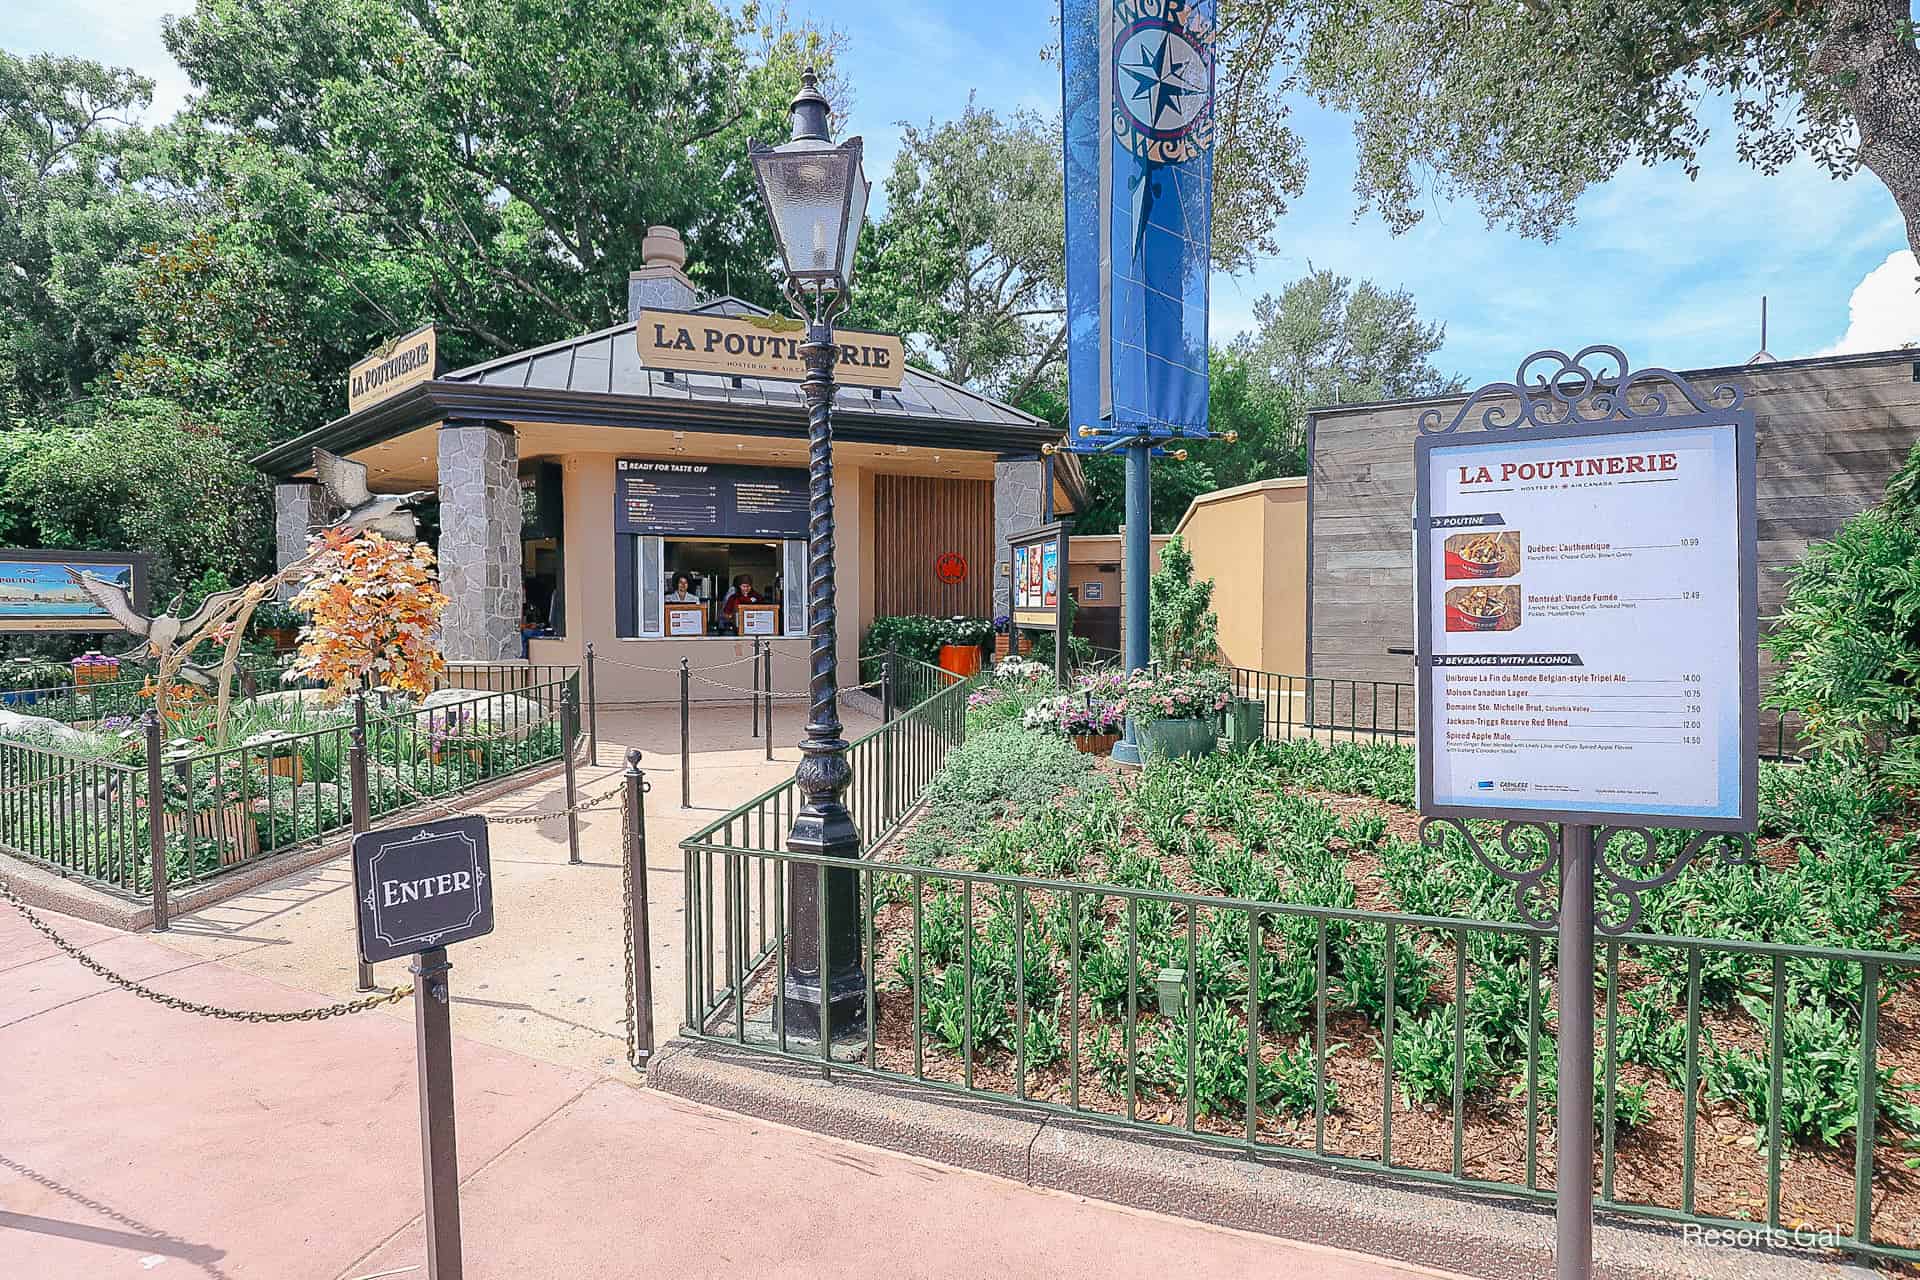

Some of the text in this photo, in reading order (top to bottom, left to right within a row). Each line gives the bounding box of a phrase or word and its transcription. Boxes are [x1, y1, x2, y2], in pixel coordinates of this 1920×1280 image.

[654, 323, 890, 369] LA POUTIRIE
[352, 375, 364, 398] LA
[365, 342, 430, 392] POUTINERIE
[629, 462, 653, 470] READY
[655, 463, 670, 471] FOR
[671, 464, 692, 472] TASTE
[1459, 453, 1678, 485] LA POUTINERIE
[1443, 517, 1485, 526] POUTINE
[1528, 544, 1557, 553] Québec:
[1565, 594, 1591, 602] Viande
[1445, 656, 1573, 665] BEVERAGES WITH ALCOHOL
[1479, 674, 1488, 682] La
[1489, 674, 1500, 682] Fin
[1502, 674, 1511, 682] du
[1513, 674, 1537, 682] Monde
[1538, 674, 1588, 684] Belgian-style
[1591, 674, 1612, 684] Tripel
[1612, 674, 1626, 682] Ale
[1446, 688, 1472, 696] Molson
[1473, 688, 1506, 696] Canadian
[1508, 689, 1528, 698] Lager
[1446, 703, 1476, 711] Domaine
[1493, 703, 1524, 711] Michelle
[1500, 718, 1530, 726] Reserve
[1531, 718, 1545, 726] Red
[1547, 718, 1568, 727] Blend
[1446, 731, 1470, 741] Spiced
[1472, 732, 1492, 741] Apple
[1493, 732, 1511, 740] Mule
